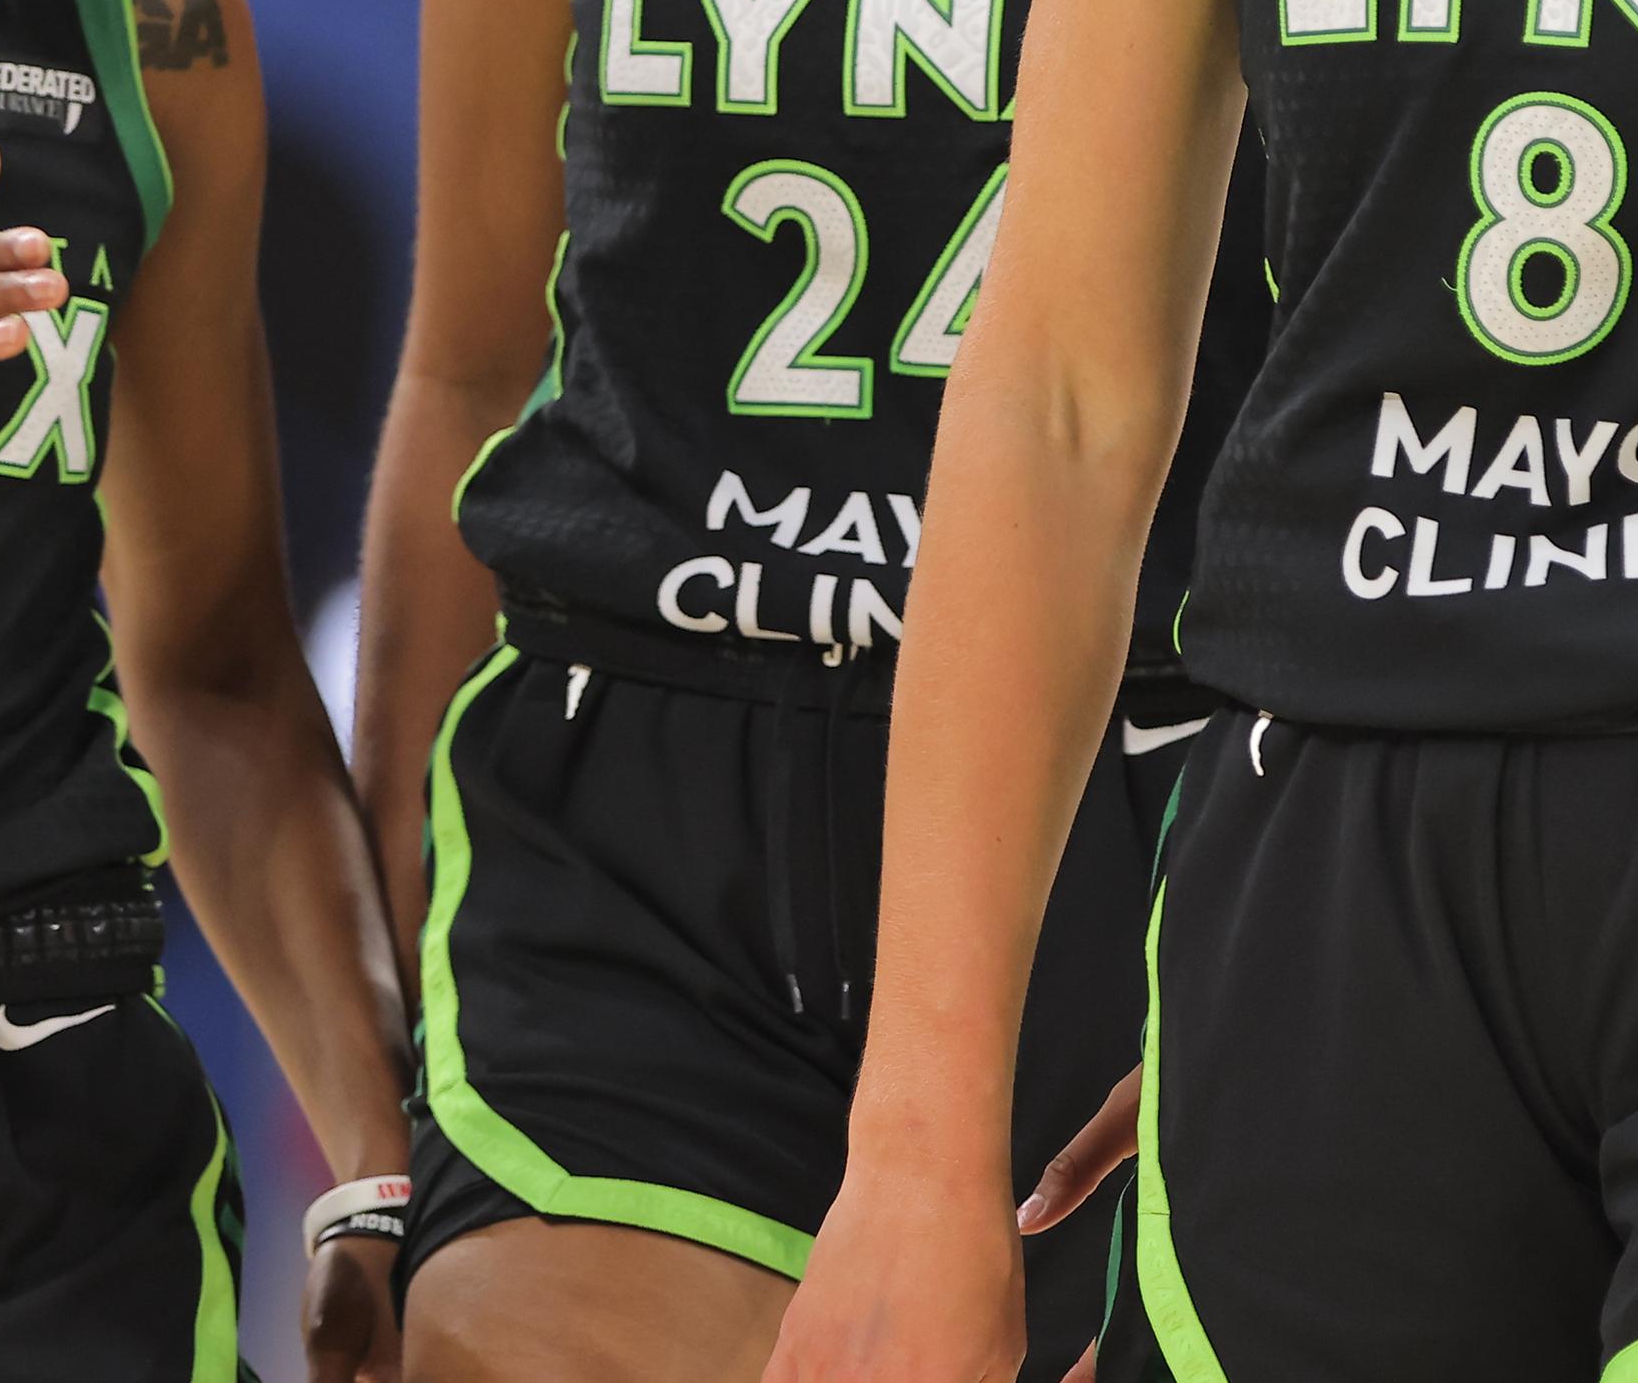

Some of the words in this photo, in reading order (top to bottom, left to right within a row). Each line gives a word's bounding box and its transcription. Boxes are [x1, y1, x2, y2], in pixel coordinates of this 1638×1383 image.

[1457, 92, 1632, 366] 8
[706, 470, 922, 569] MAY
[657, 556, 903, 668] CLIN
